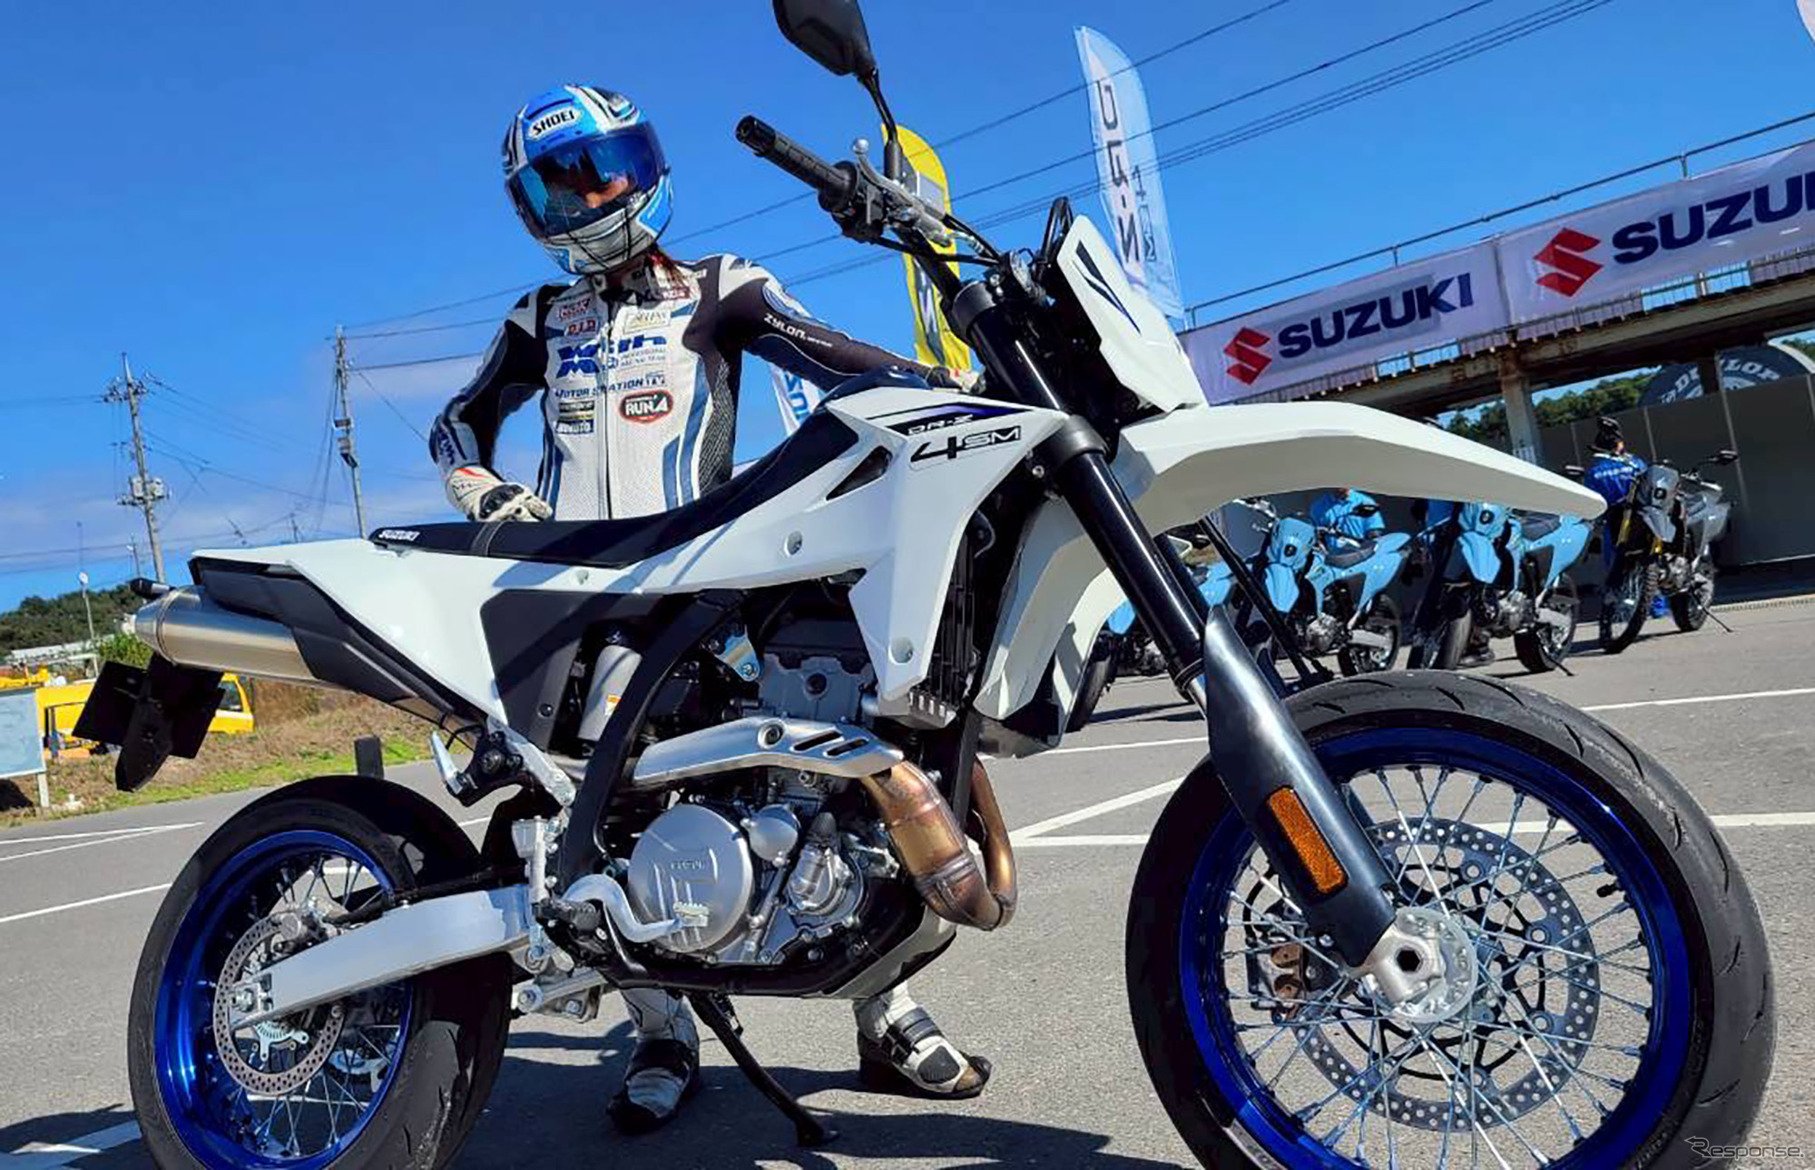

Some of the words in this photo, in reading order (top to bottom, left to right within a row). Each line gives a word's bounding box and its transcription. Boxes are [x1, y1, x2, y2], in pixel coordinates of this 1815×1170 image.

[532, 110, 575, 135] SHOEI
[1612, 171, 1815, 264] SUZU
[1278, 272, 1473, 358] SUZUKI
